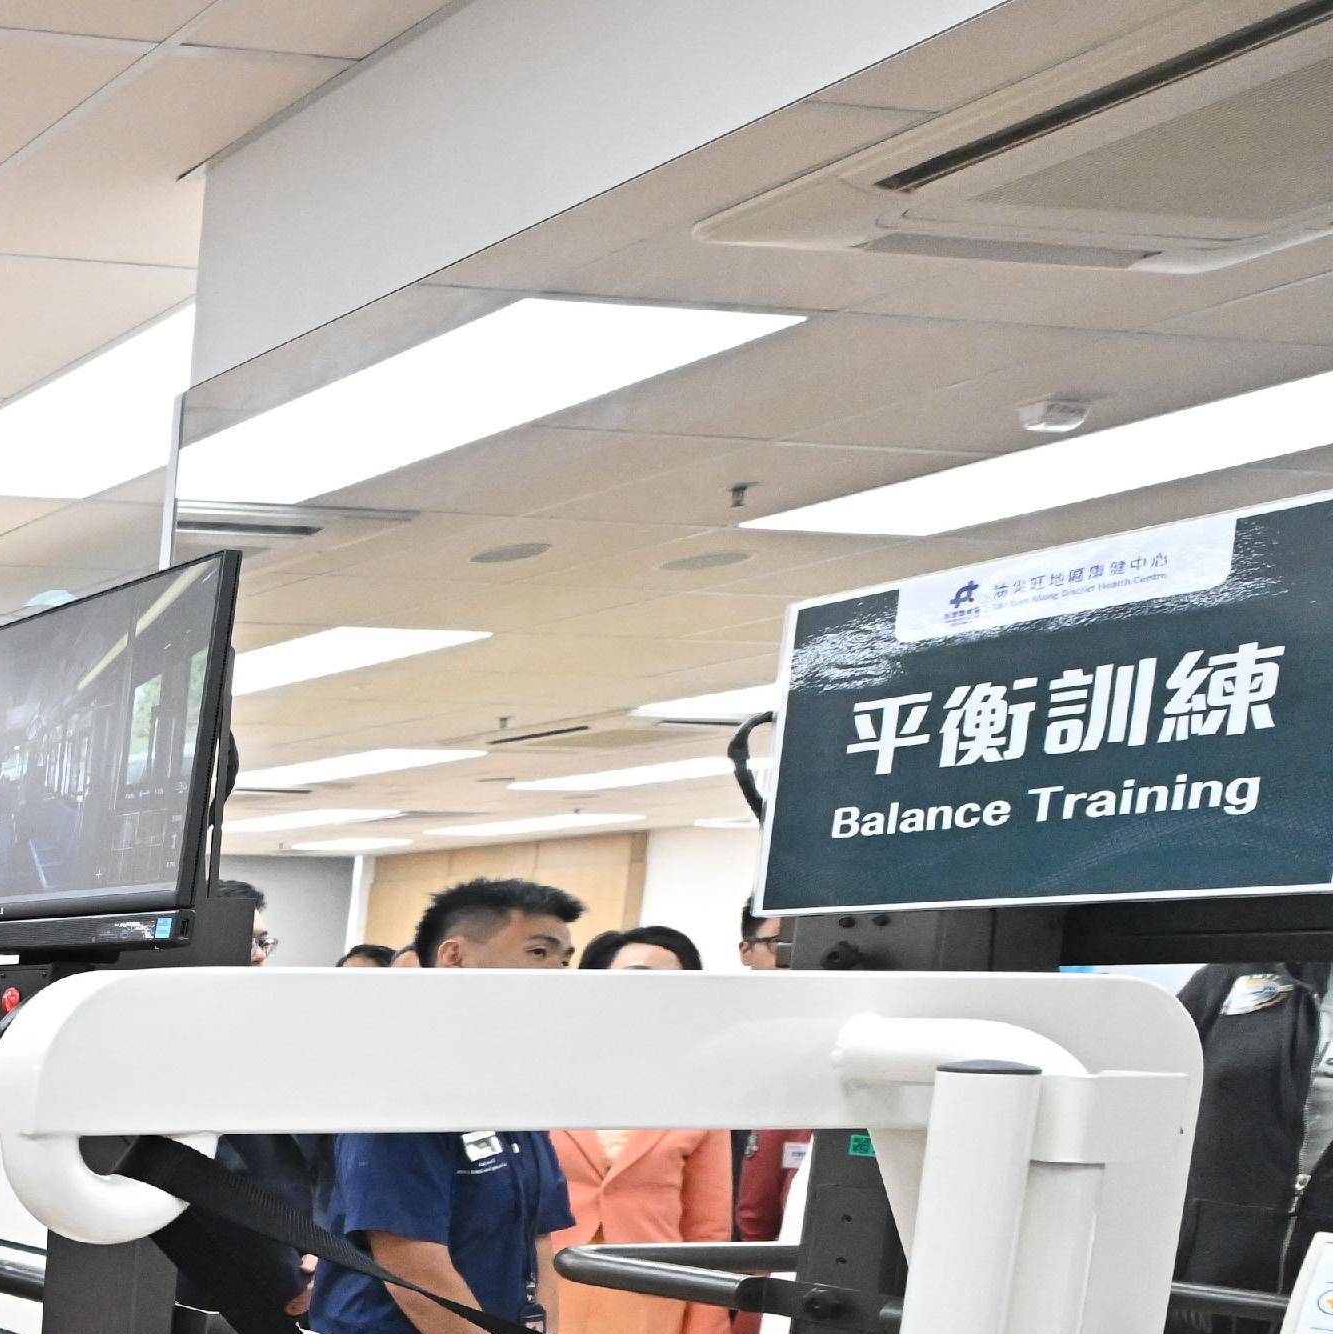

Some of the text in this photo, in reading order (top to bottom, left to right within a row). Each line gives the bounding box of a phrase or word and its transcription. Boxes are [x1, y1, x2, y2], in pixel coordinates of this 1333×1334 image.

[846, 641, 1285, 776] 平衡訓練
[831, 773, 1262, 841] Balance Training
